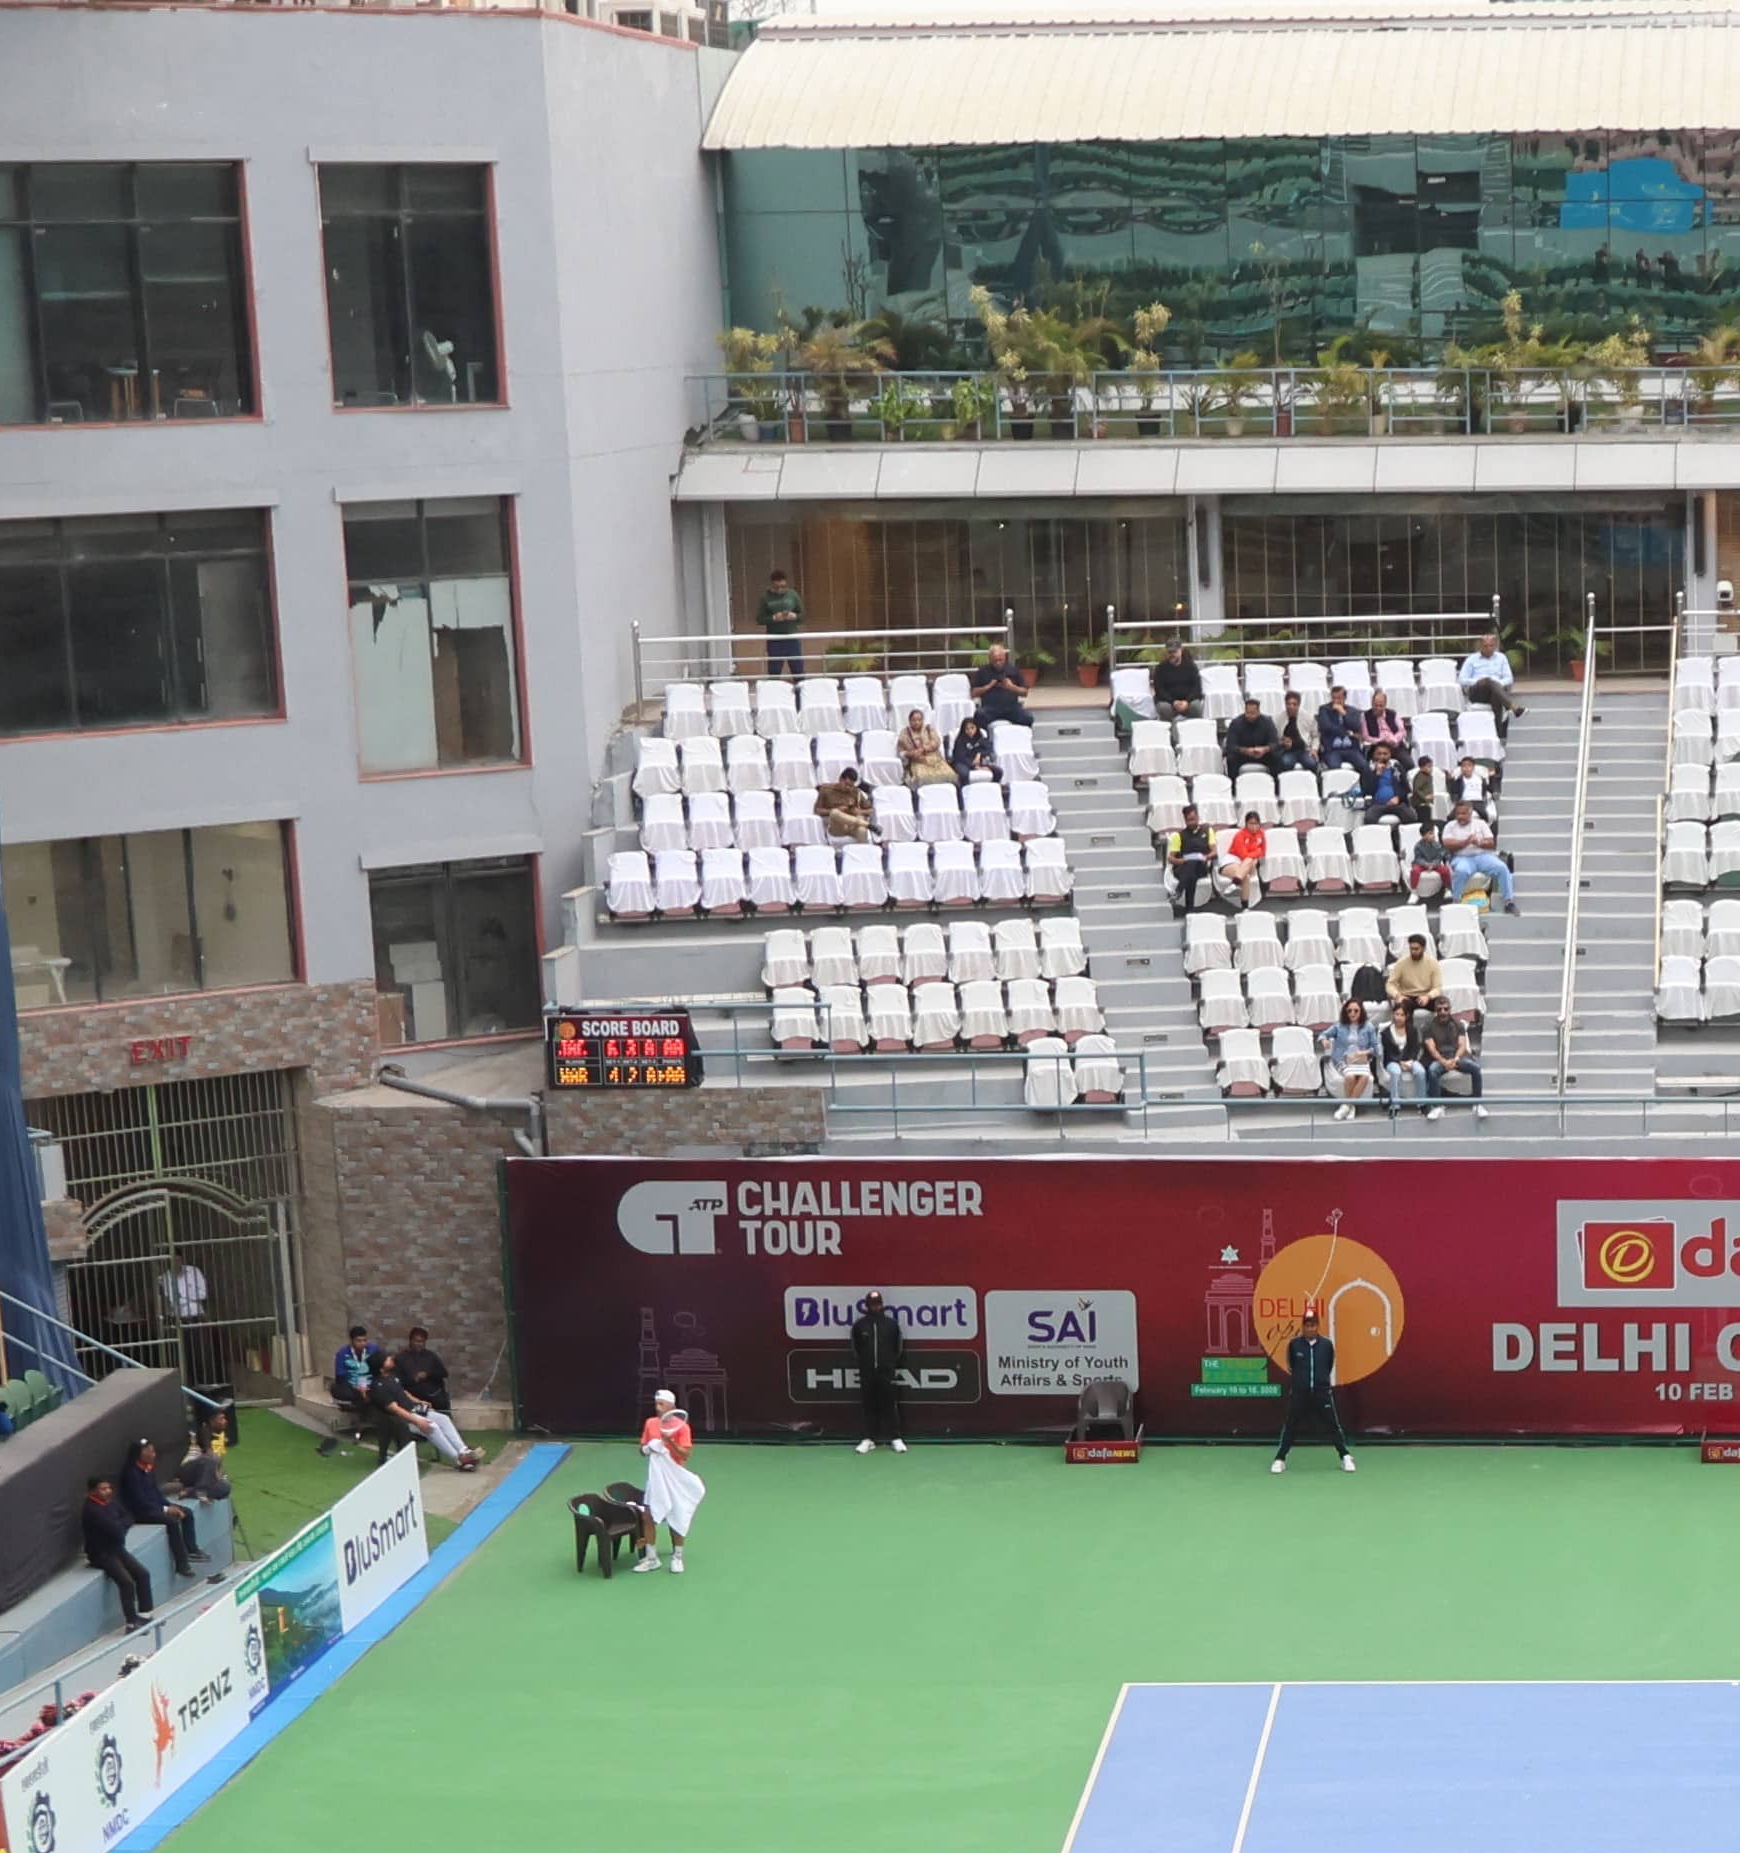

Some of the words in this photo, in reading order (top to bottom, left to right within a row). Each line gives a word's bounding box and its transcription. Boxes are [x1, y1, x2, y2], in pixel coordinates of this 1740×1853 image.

[582, 1020, 628, 1037] SCORE
[632, 1020, 680, 1037] BOARD
[132, 1035, 192, 1064] EXIT
[688, 1200, 723, 1211] ATP
[737, 1180, 984, 1217] CHALLENGER
[739, 1220, 843, 1255] TOUR
[1028, 1310, 1096, 1343] SAI
[999, 1356, 1059, 1372] Ministry
[1065, 1355, 1081, 1368] of
[1084, 1356, 1129, 1369] Youth
[1493, 1323, 1691, 1373] DELHI
[1000, 1374, 1051, 1387] Affairs
[1057, 1374, 1067, 1387] &
[1656, 1383, 1682, 1401] 10
[1690, 1383, 1734, 1401] FEB
[178, 1667, 232, 1731] TRENZ
[102, 1808, 129, 1843] NMDC
